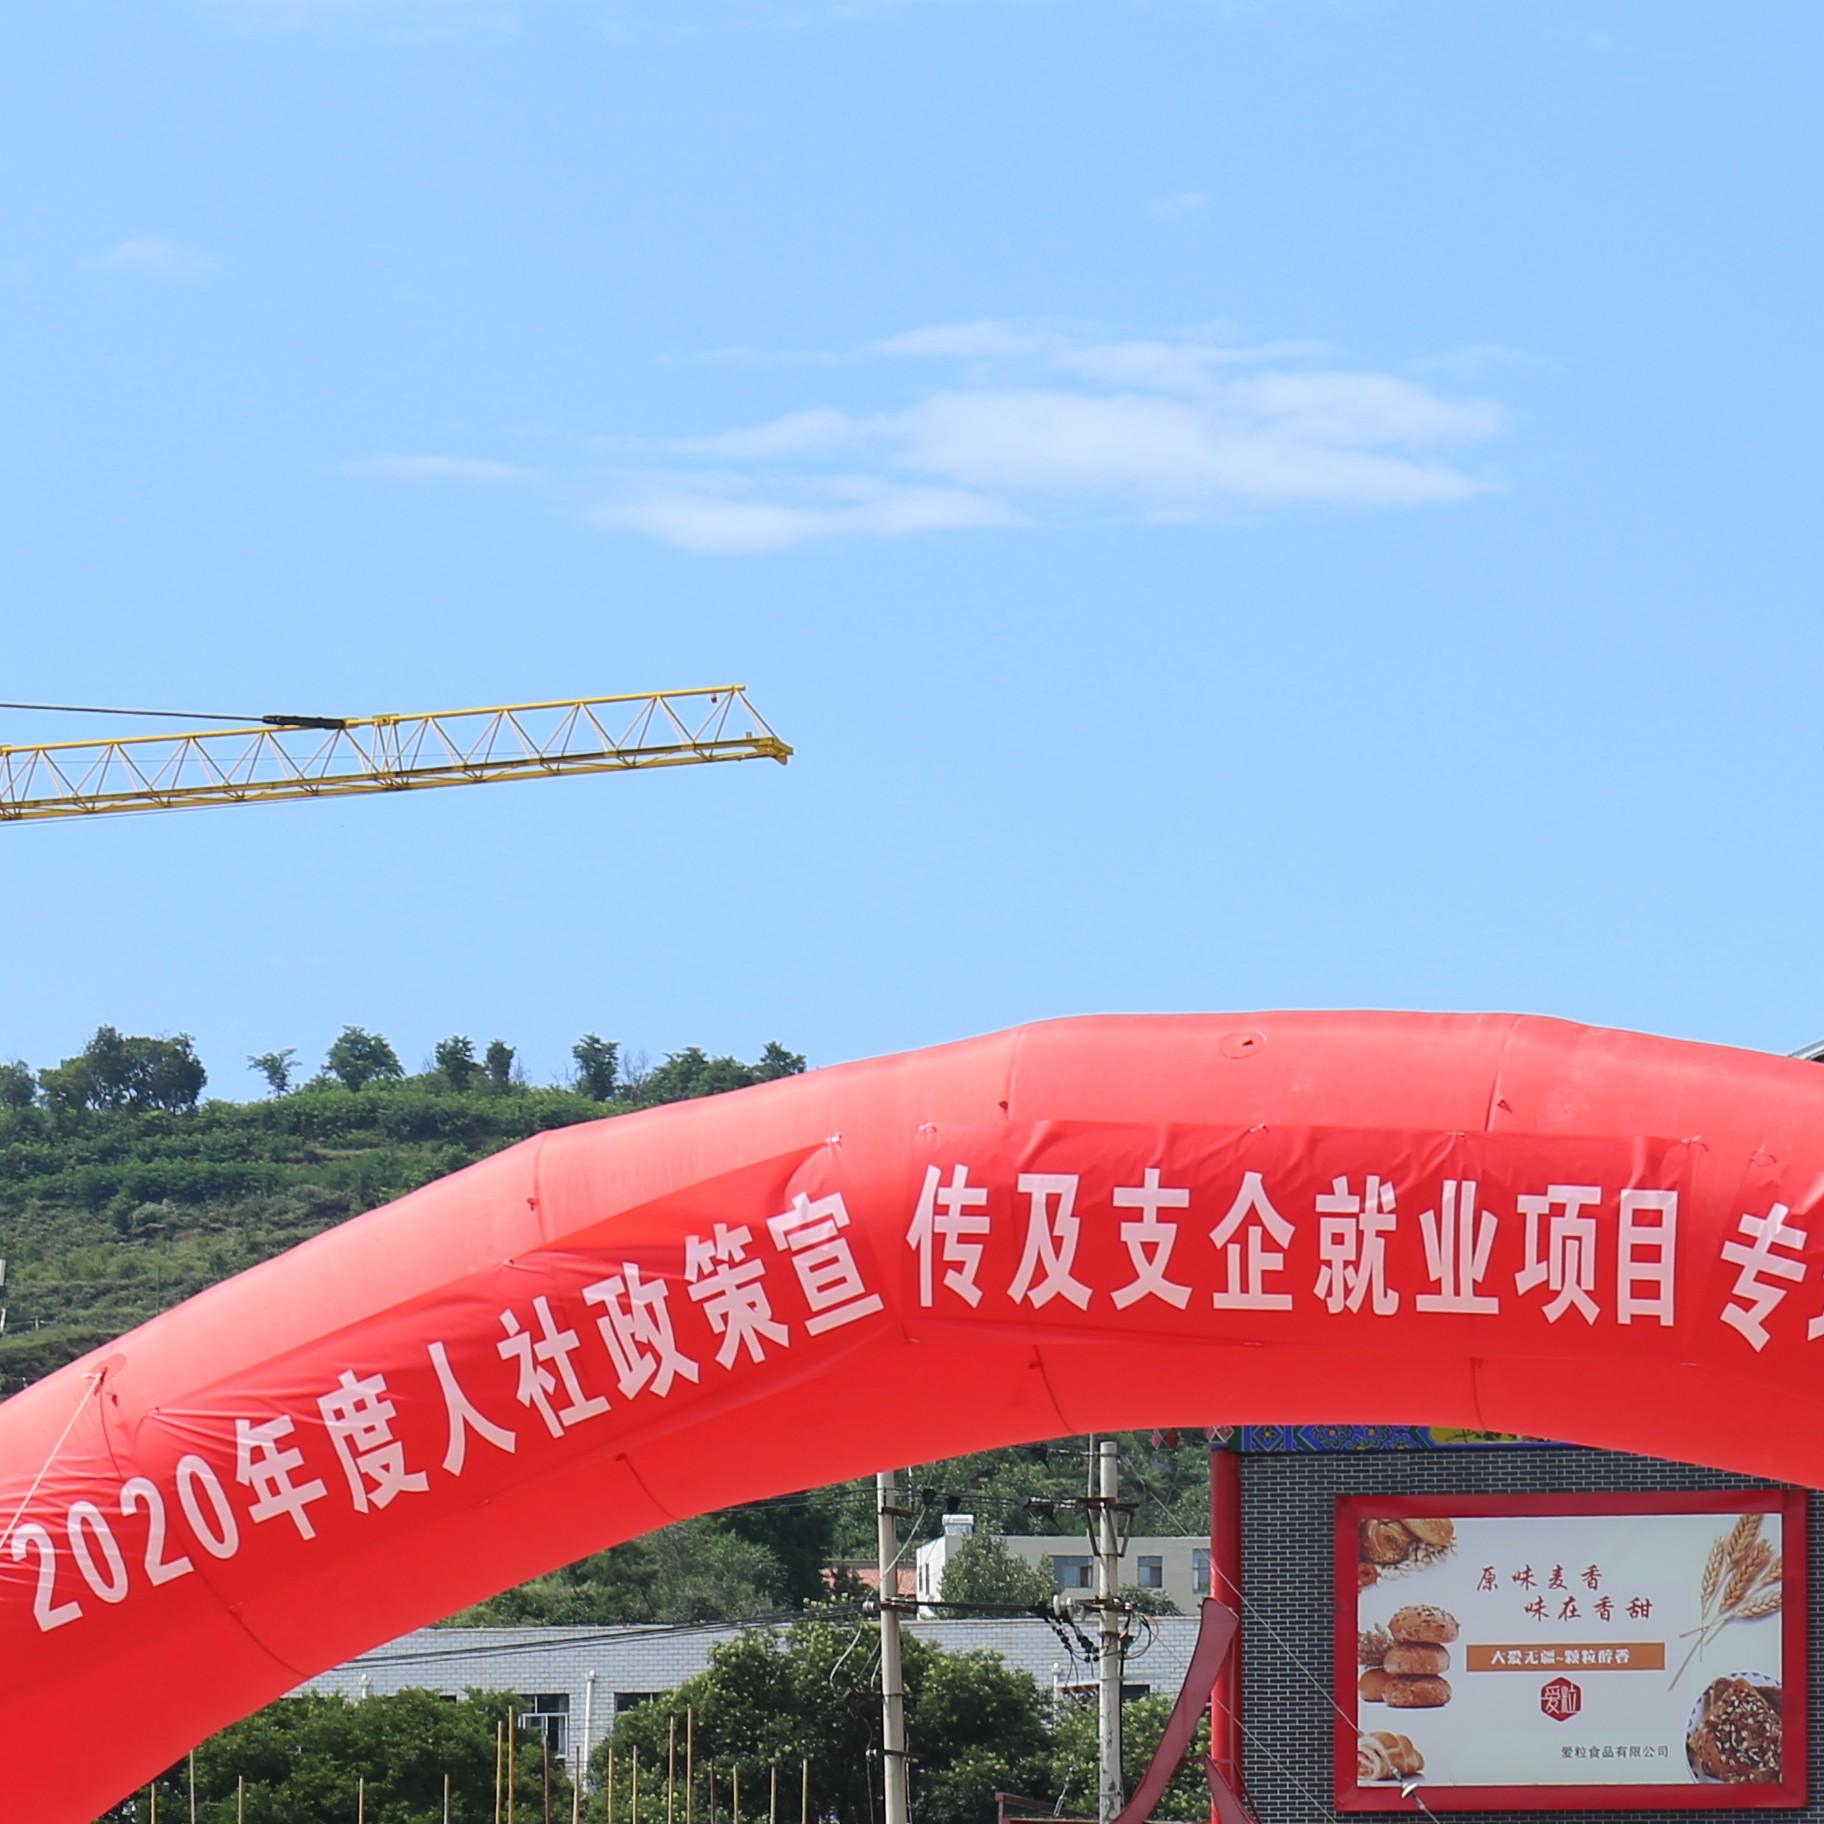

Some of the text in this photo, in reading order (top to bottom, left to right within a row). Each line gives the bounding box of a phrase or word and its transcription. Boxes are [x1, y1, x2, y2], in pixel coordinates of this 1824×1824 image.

[1476, 1564, 1602, 1592] 原味麦香
[1524, 1595, 1653, 1622] 味在香甜
[1560, 1744, 1669, 1758] 爱粒食品有限公司
